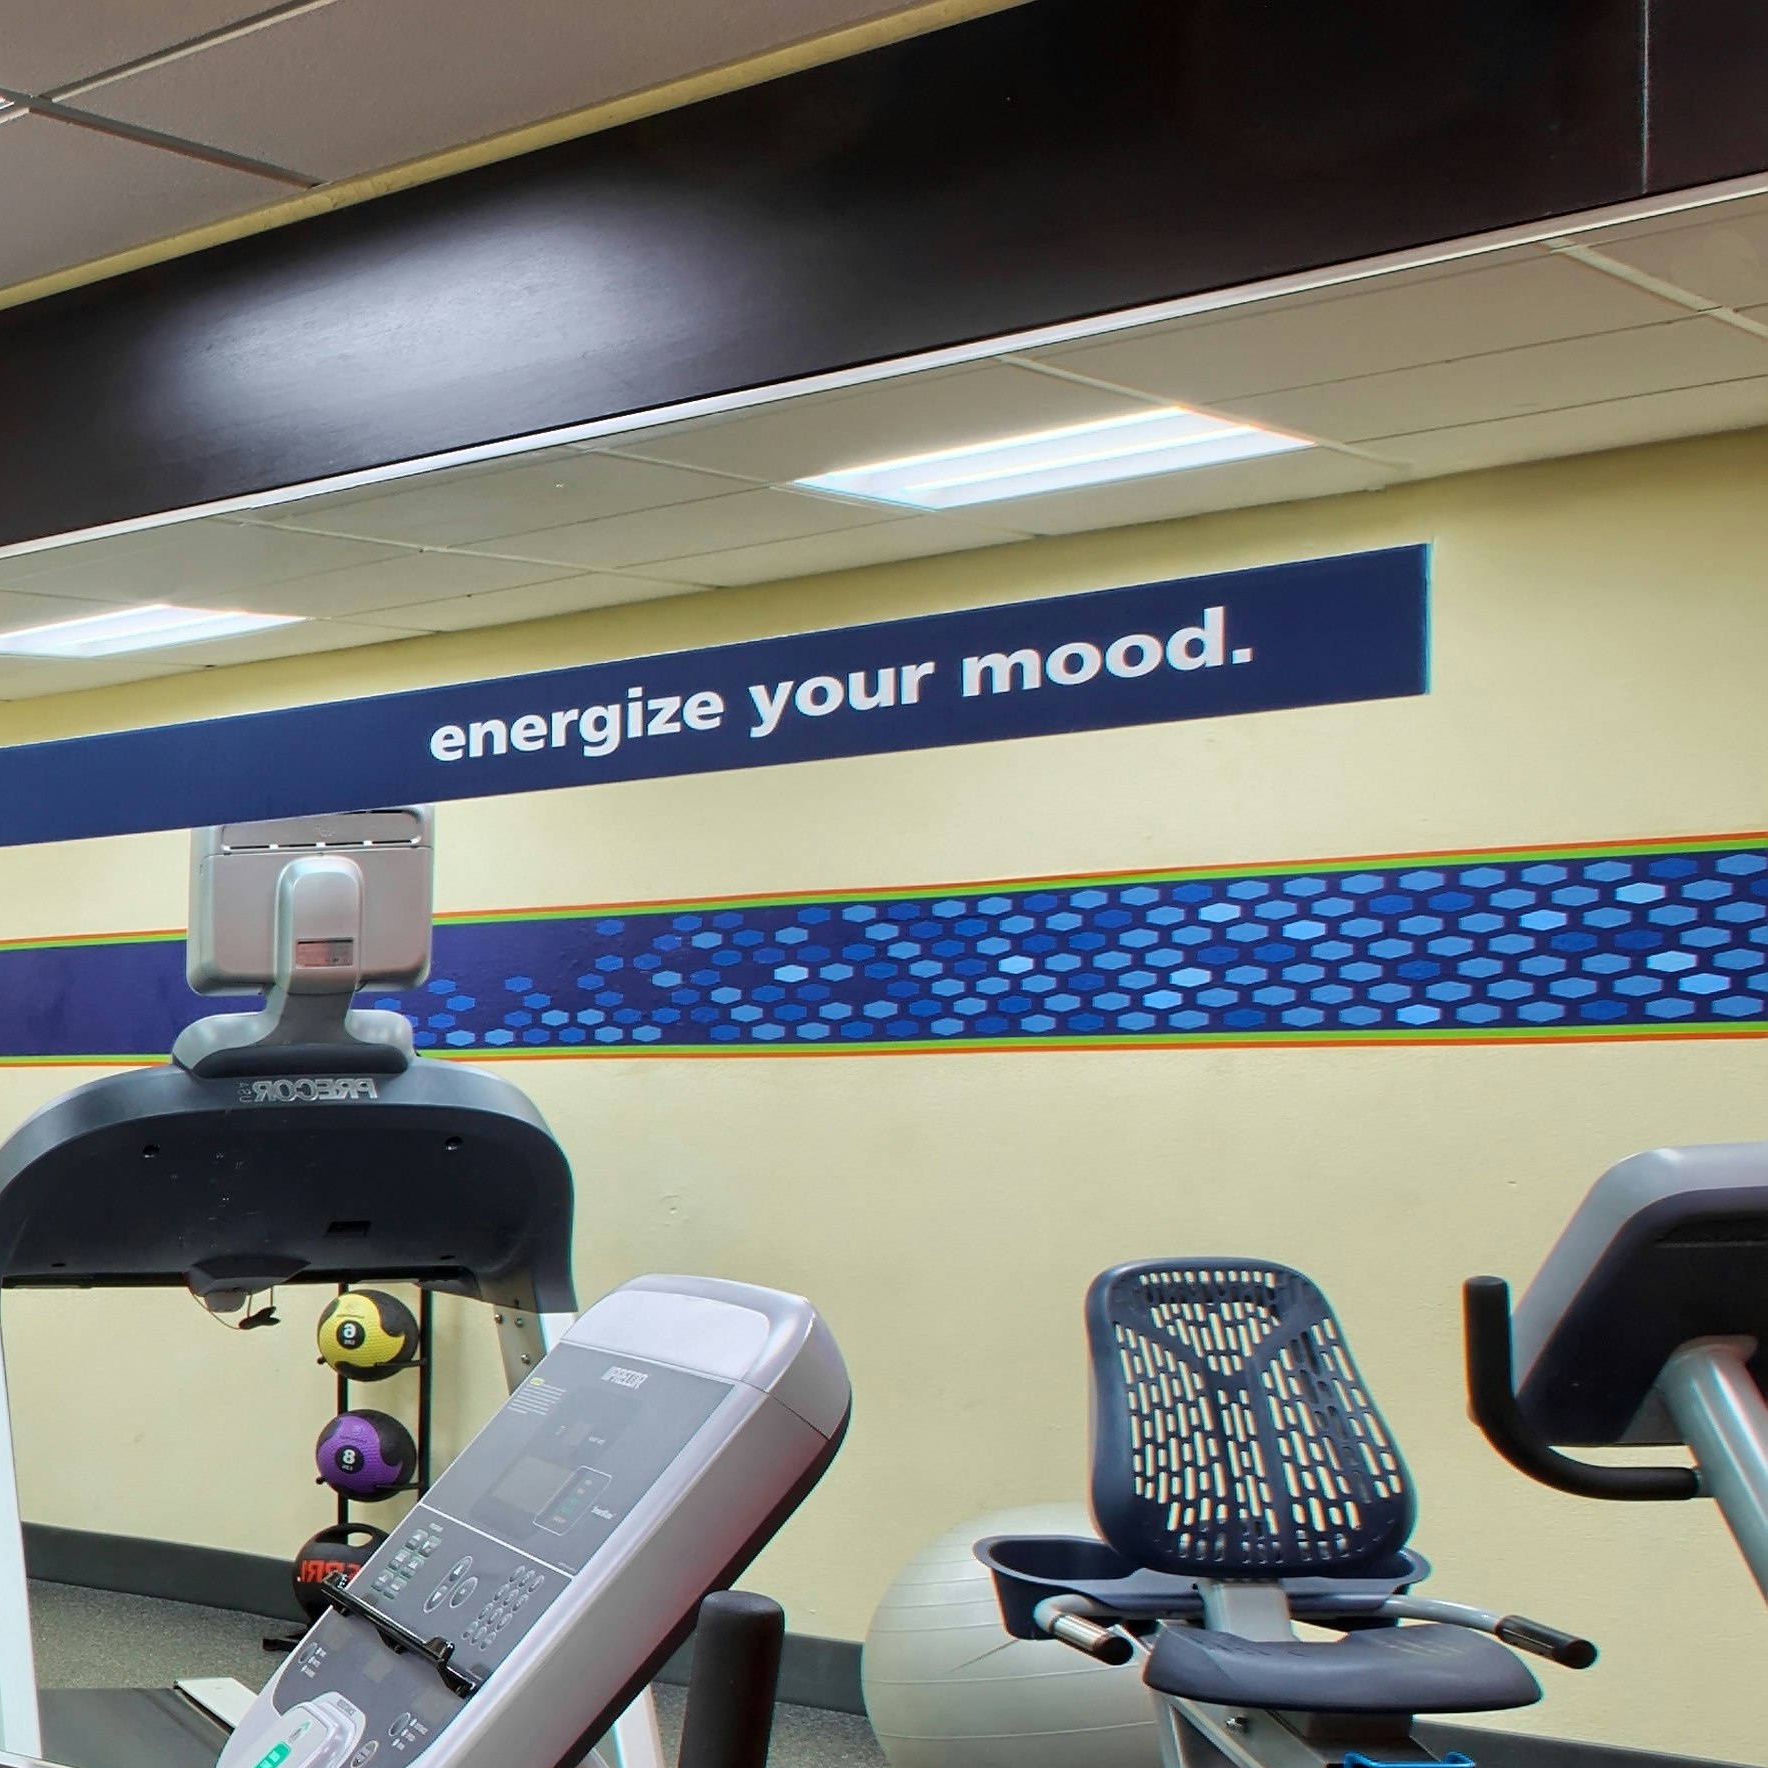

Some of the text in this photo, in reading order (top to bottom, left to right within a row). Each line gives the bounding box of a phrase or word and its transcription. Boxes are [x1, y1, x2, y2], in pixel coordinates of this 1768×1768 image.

[430, 606, 1253, 763] energize your mood.
